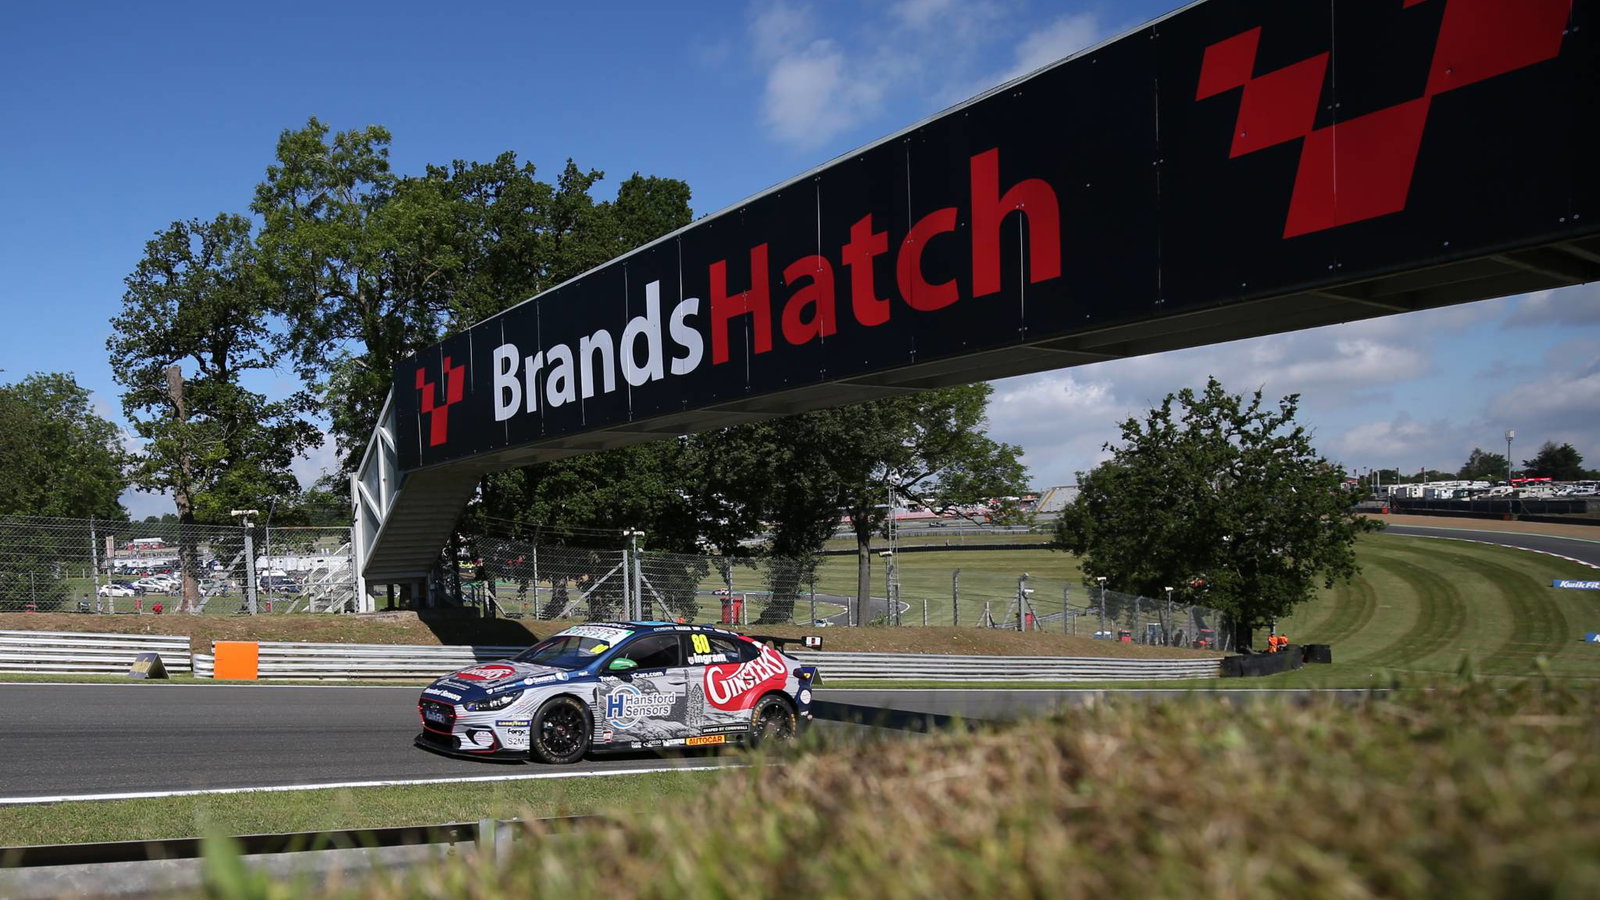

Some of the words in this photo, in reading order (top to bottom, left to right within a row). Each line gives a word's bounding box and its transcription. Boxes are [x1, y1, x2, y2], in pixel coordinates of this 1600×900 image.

[691, 634, 711, 654] 80
[693, 653, 727, 665] Ingram
[625, 692, 675, 705] Hansford
[625, 705, 669, 717] Sensors
[507, 737, 525, 746] S2M
[688, 735, 723, 745] AUTOCAR
